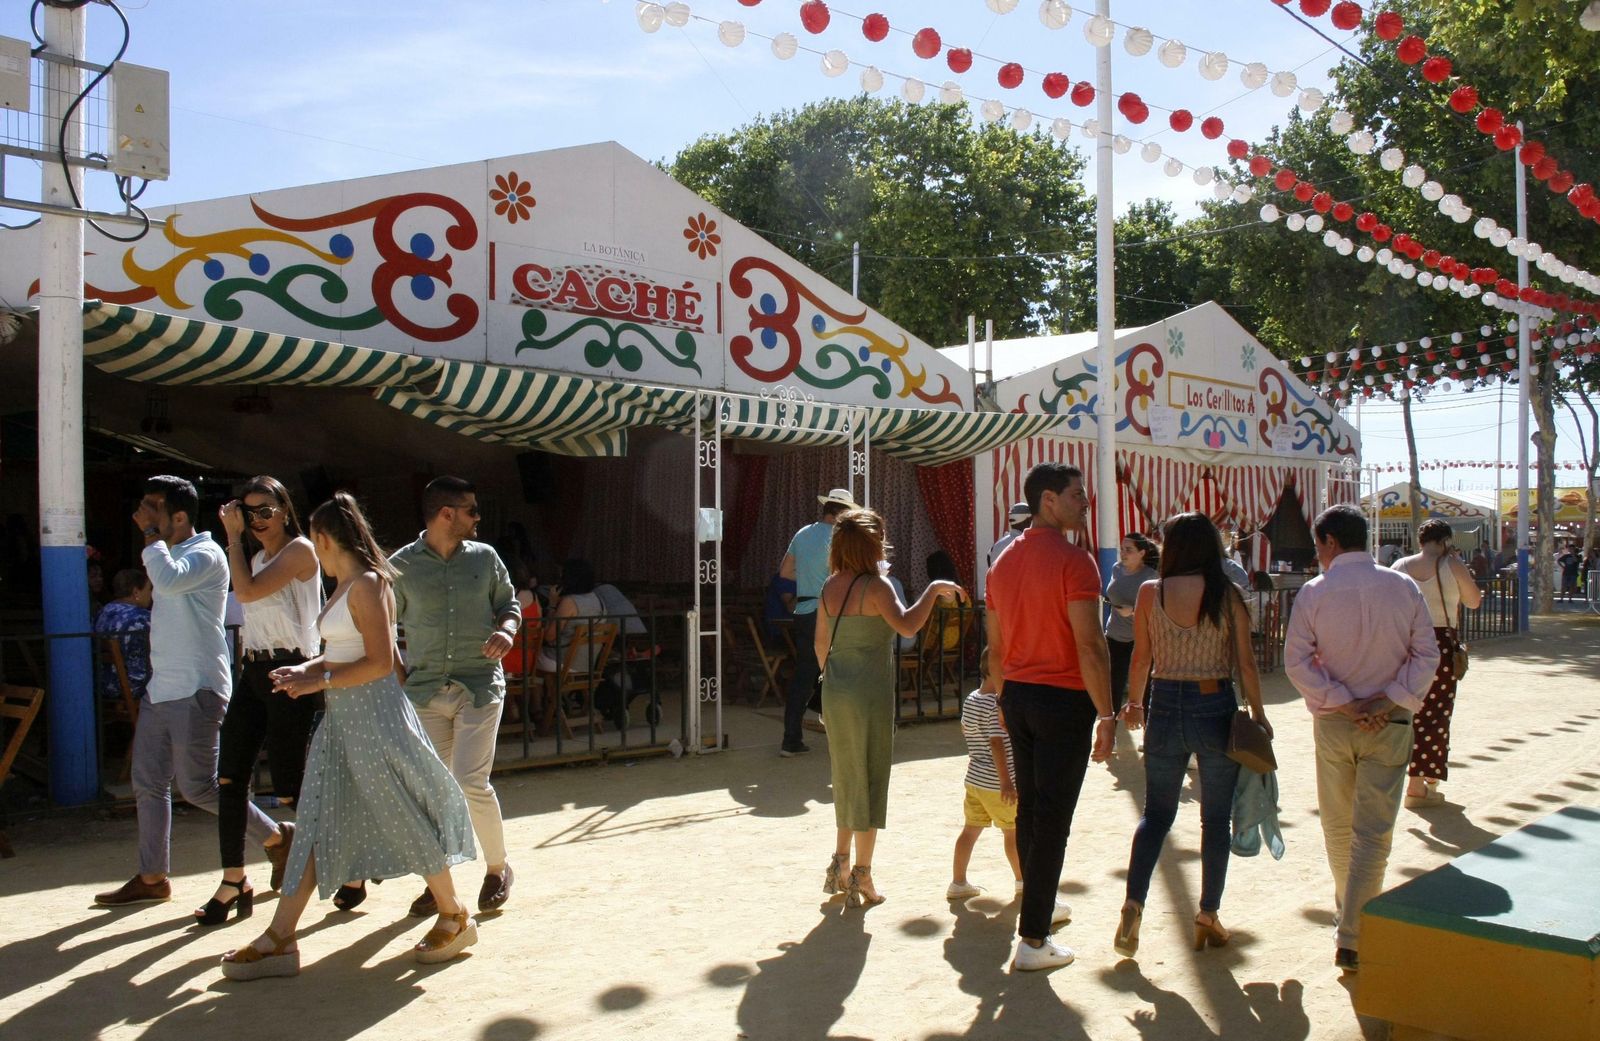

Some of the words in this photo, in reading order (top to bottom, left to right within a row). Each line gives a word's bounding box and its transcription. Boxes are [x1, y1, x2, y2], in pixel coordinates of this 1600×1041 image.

[584, 242, 597, 252] LA
[512, 263, 704, 326] CACHÉ
[1187, 384, 1203, 408] Los
